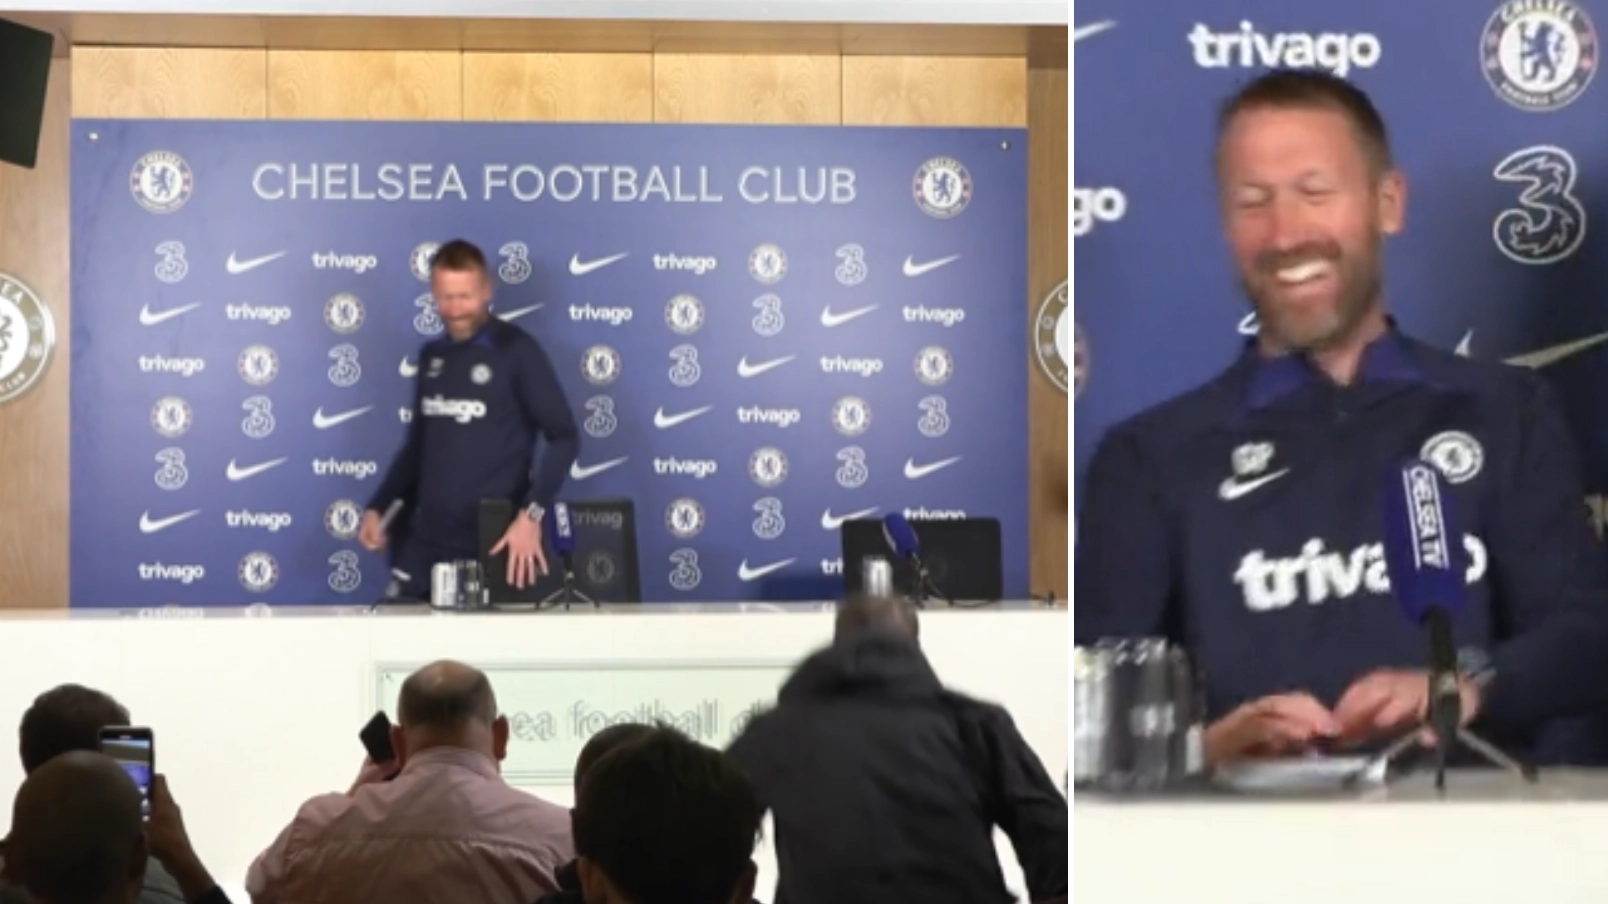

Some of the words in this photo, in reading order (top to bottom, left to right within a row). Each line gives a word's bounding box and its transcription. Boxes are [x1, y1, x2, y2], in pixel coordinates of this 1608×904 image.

[1187, 19, 1382, 78] trivago
[252, 162, 467, 201] CHELSEA
[483, 164, 723, 203] FOOTBALL
[739, 166, 857, 204] CLUB
[312, 251, 377, 273] trivago
[653, 252, 717, 274] trivago
[226, 303, 291, 325] trivago
[569, 303, 632, 325] trivago
[902, 304, 965, 326] trivago
[139, 355, 205, 377] trivago
[820, 354, 884, 376] trivago
[737, 405, 801, 427] trivago
[312, 457, 377, 479] trivago
[653, 456, 717, 478] trivago
[225, 509, 291, 531] trivago
[572, 508, 623, 530] trivag
[139, 561, 205, 583] trivago
